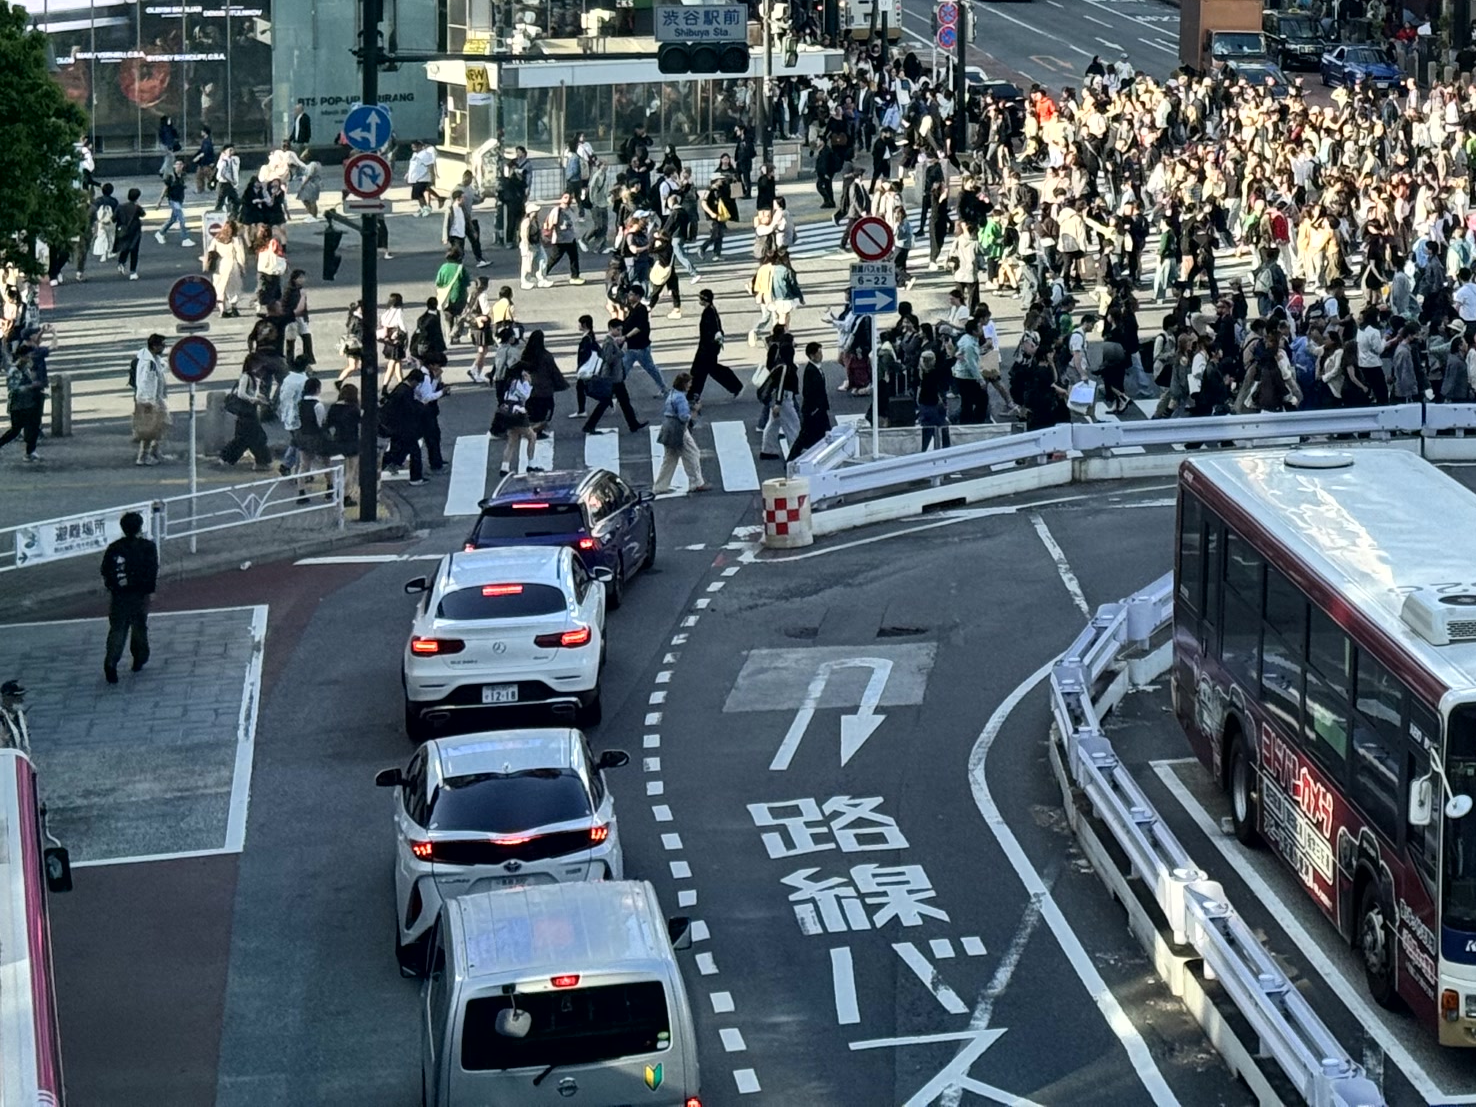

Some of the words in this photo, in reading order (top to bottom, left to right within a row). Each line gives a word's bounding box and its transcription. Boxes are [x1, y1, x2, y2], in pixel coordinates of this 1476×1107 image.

[662, 8, 741, 27] 渋谷駅前
[674, 27, 710, 39] Shibuya
[712, 27, 732, 38] Sta.
[319, 95, 361, 106] POP-UP
[746, 795, 1047, 1107] 路線バス
